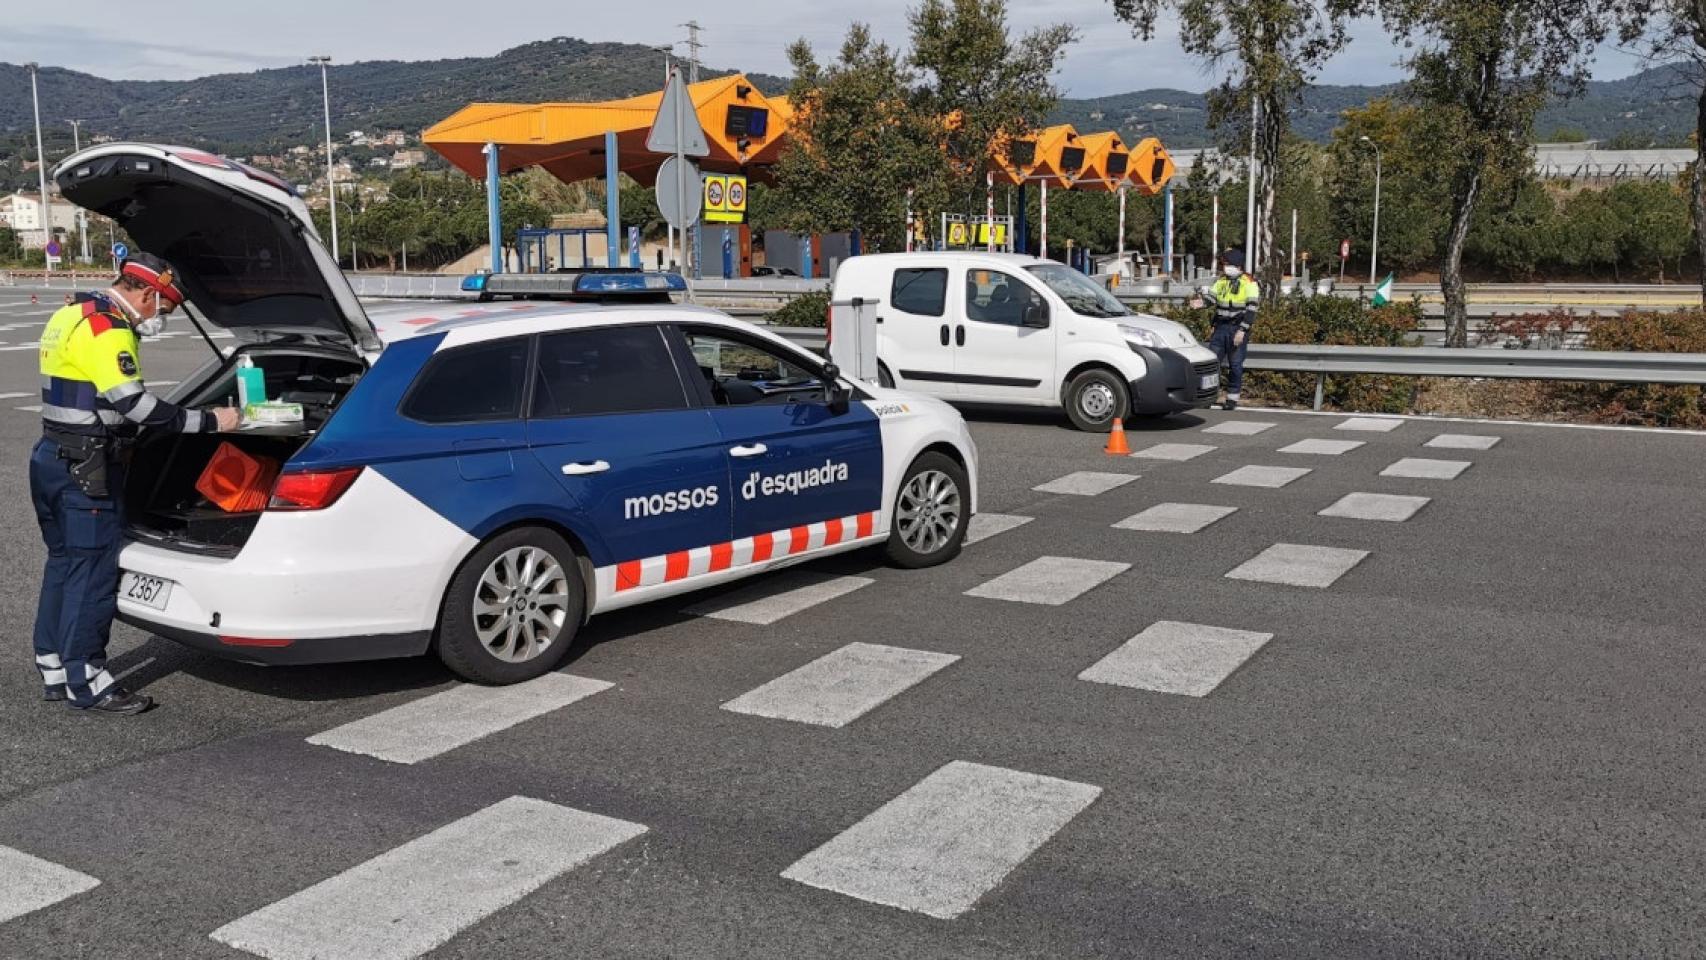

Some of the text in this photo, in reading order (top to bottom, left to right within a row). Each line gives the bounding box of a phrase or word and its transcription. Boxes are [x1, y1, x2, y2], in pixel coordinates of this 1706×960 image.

[624, 459, 849, 520] mossos d'esquadra
[128, 574, 164, 603] 2367
